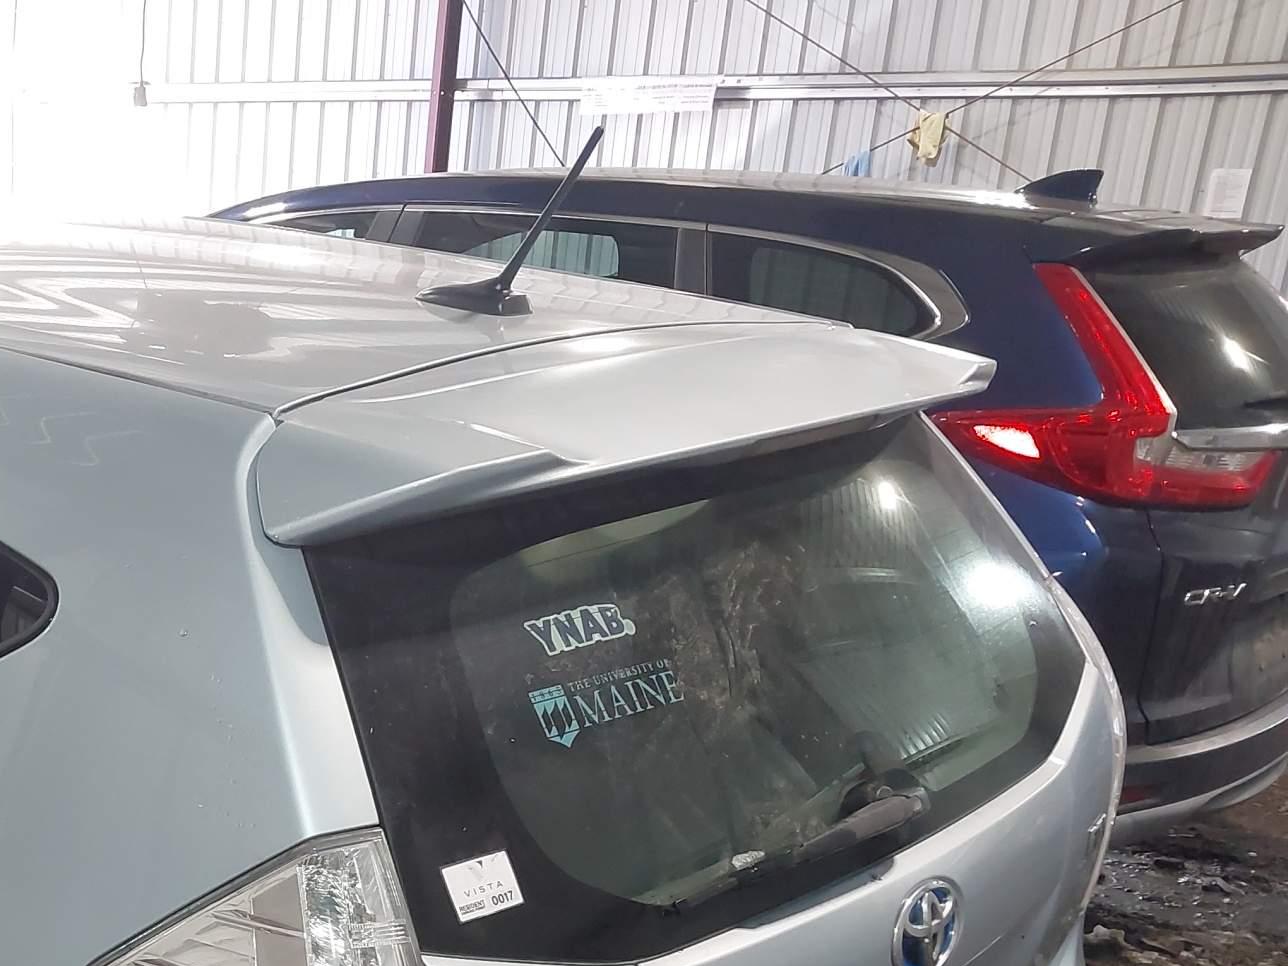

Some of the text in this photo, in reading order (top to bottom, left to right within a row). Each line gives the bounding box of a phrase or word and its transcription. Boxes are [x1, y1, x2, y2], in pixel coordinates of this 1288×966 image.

[1184, 582, 1247, 605] CR-V
[567, 658, 671, 692] THE UNIVERSITY OF
[573, 671, 685, 728] MAINE
[464, 881, 504, 897] VISTA
[491, 890, 513, 906] 0017
